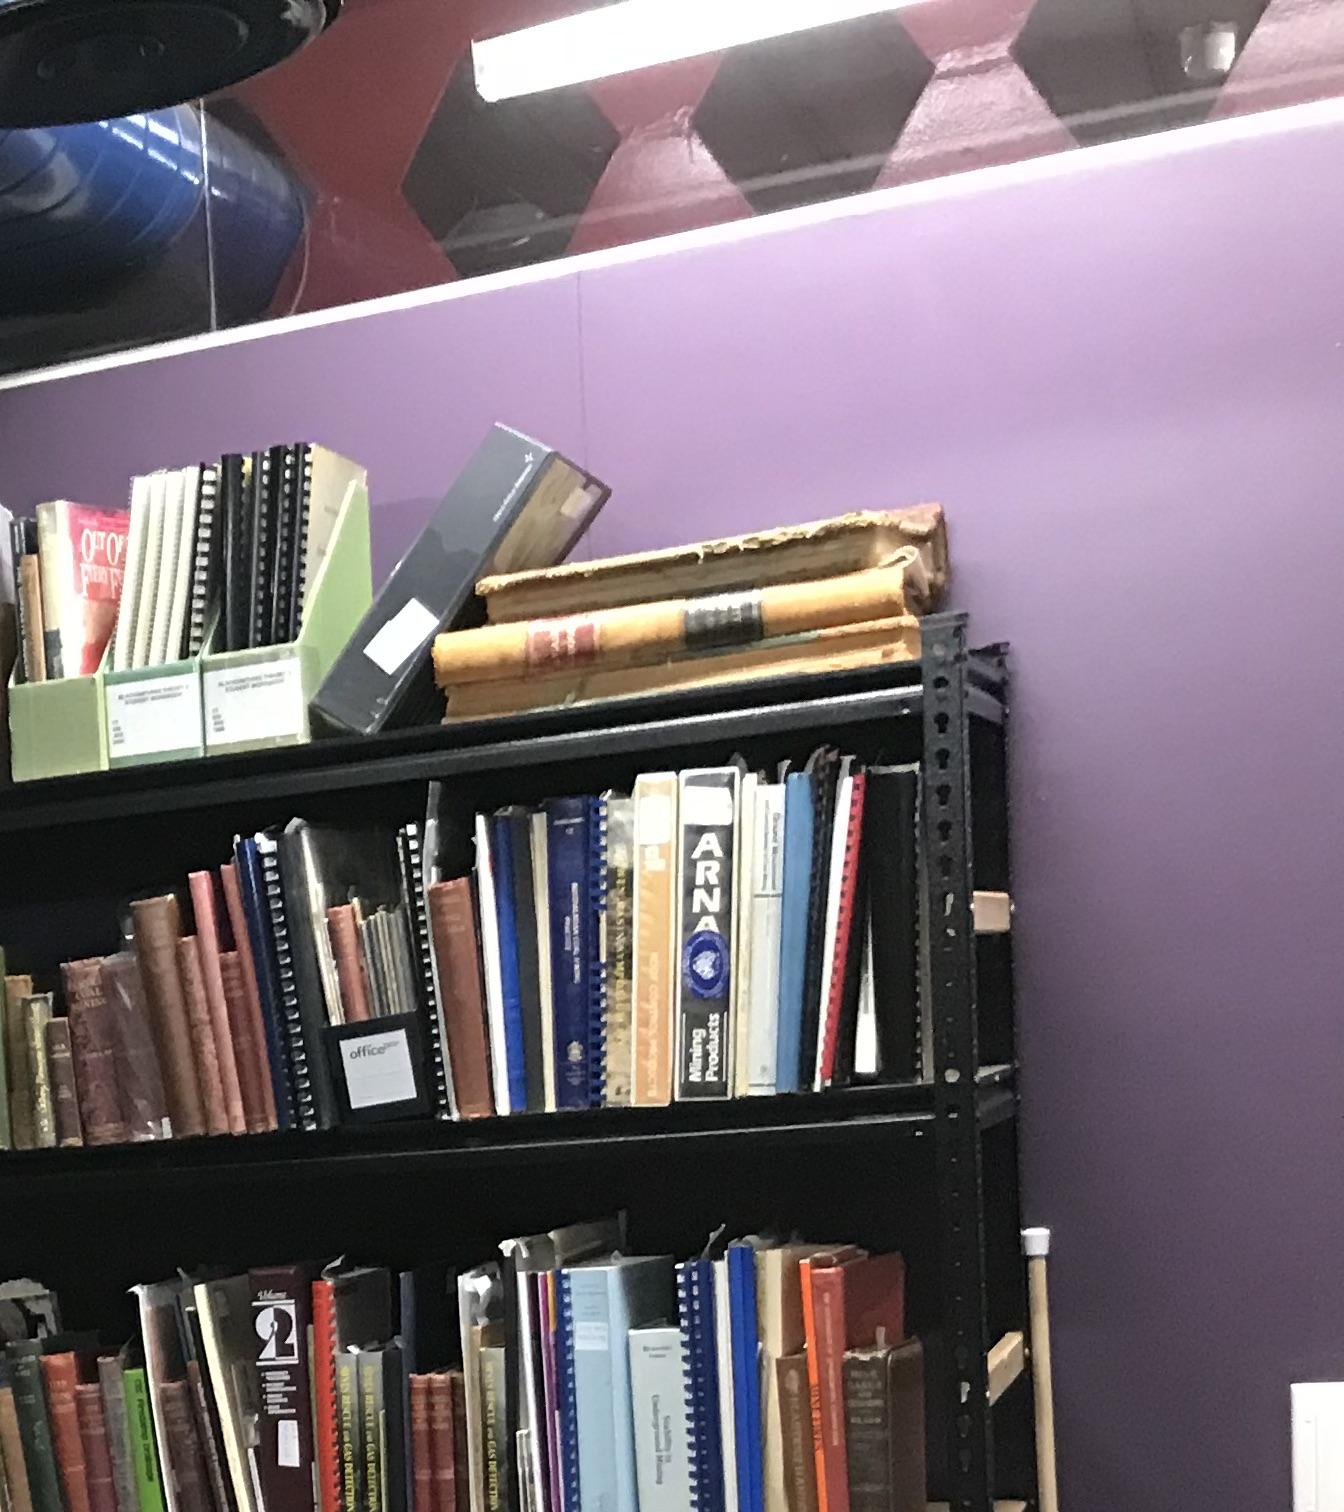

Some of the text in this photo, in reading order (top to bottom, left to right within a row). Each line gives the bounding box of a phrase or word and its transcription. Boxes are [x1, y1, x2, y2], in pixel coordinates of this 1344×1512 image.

[349, 1044, 386, 1059] office
[688, 1027, 706, 1082] Mining
[704, 1012, 720, 1081] Products
[255, 1306, 296, 1359] 2
[344, 1443, 354, 1461] GAS
[366, 1443, 376, 1461] GAS
[487, 1441, 497, 1459] GAS
[651, 1394, 663, 1485] Underground Mining
[344, 1463, 355, 1512] DETECTION
[366, 1463, 378, 1512] DETECTION
[488, 1460, 499, 1511] DETECTION
